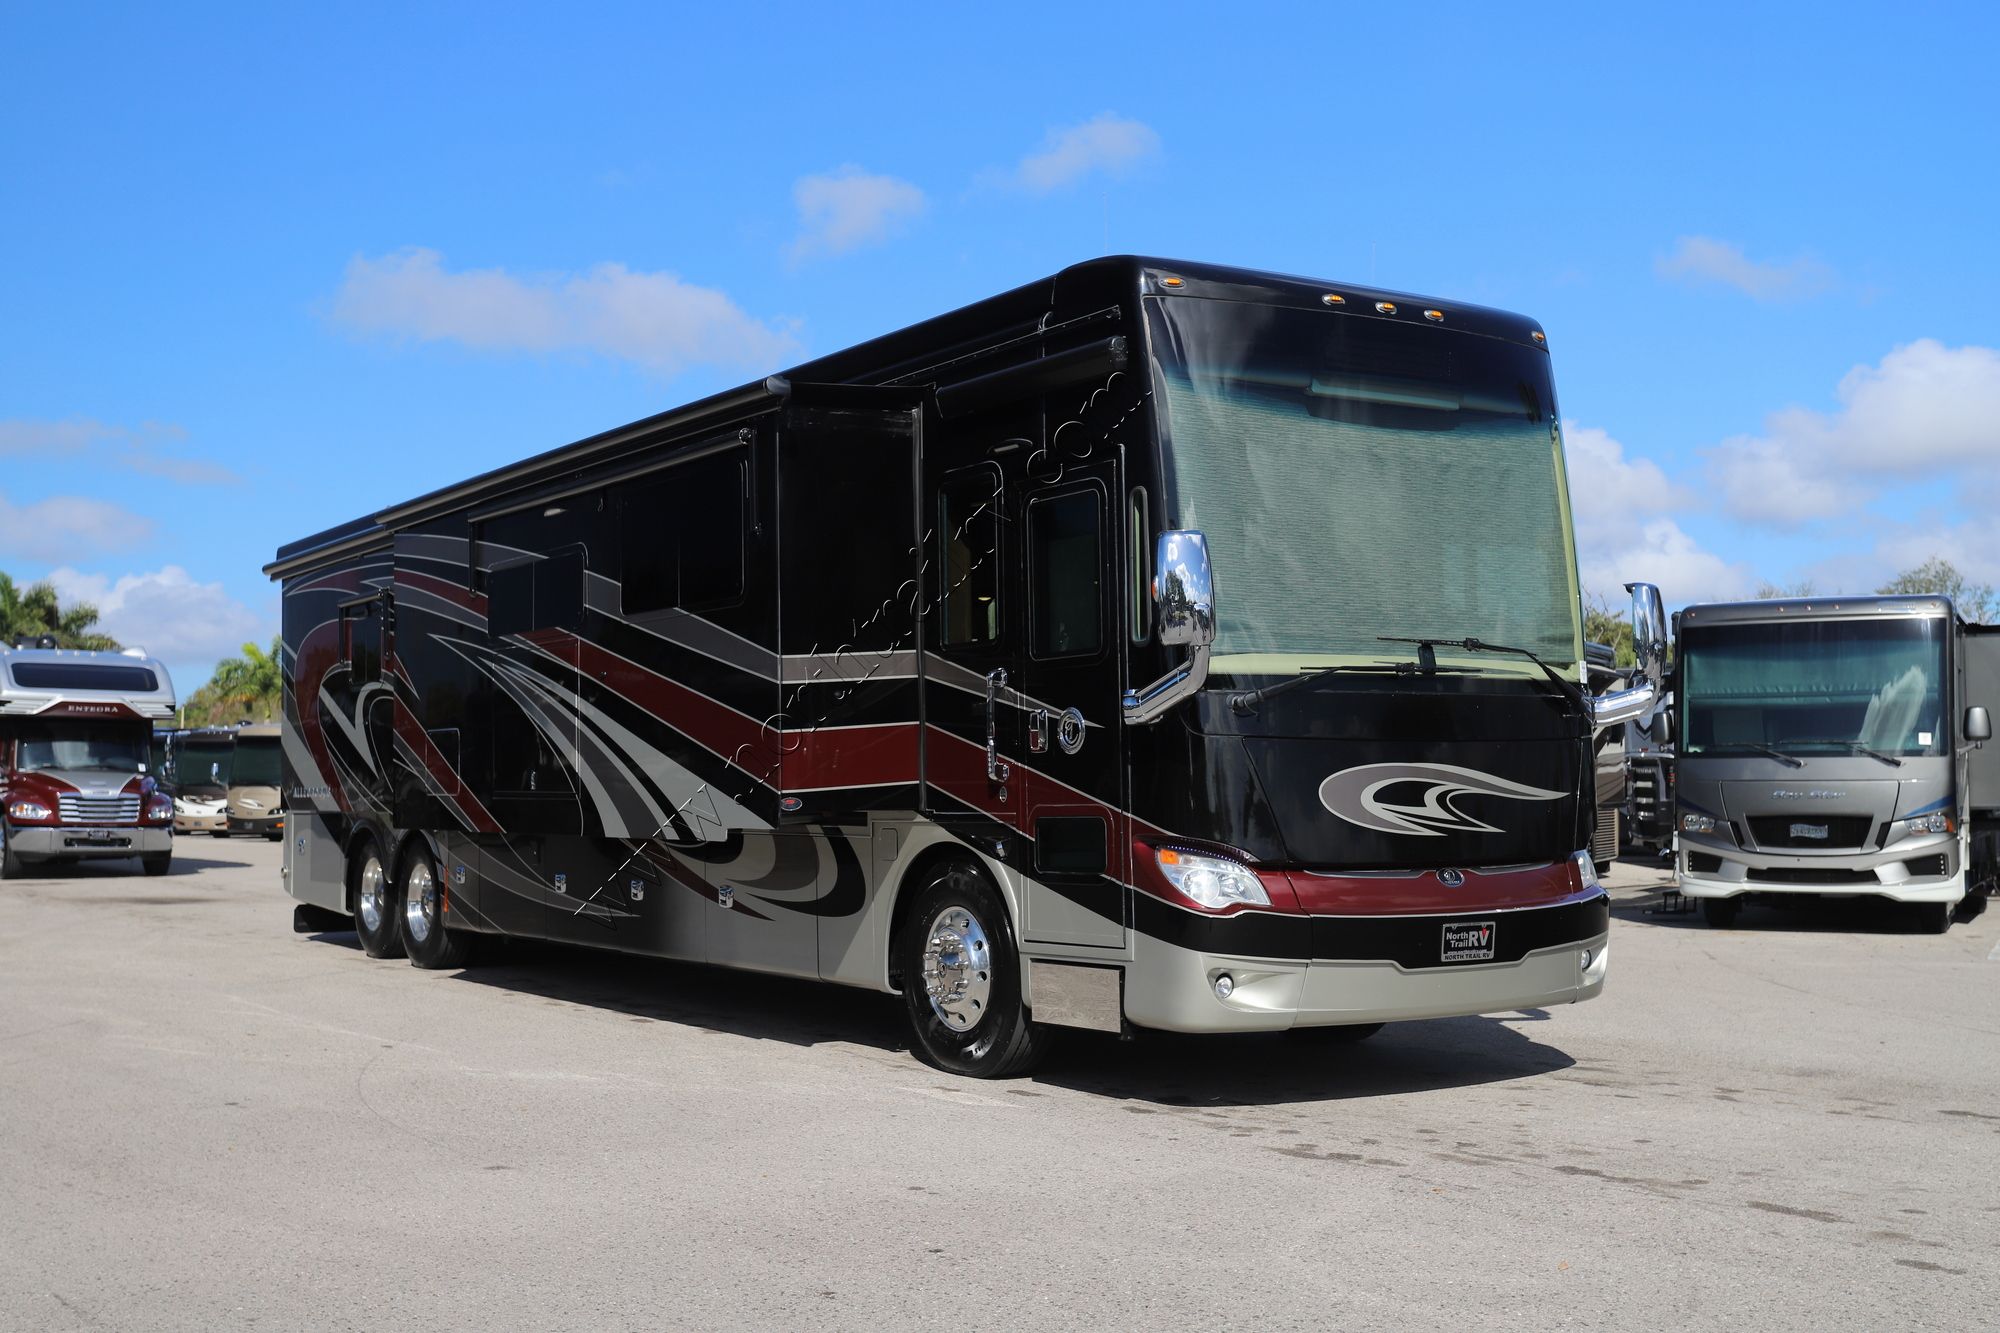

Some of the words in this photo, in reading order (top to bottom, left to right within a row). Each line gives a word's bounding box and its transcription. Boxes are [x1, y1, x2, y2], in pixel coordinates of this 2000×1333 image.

[1446, 931, 1468, 940] North
[1468, 930, 1490, 947] RV
[1450, 940, 1468, 948] Trail
